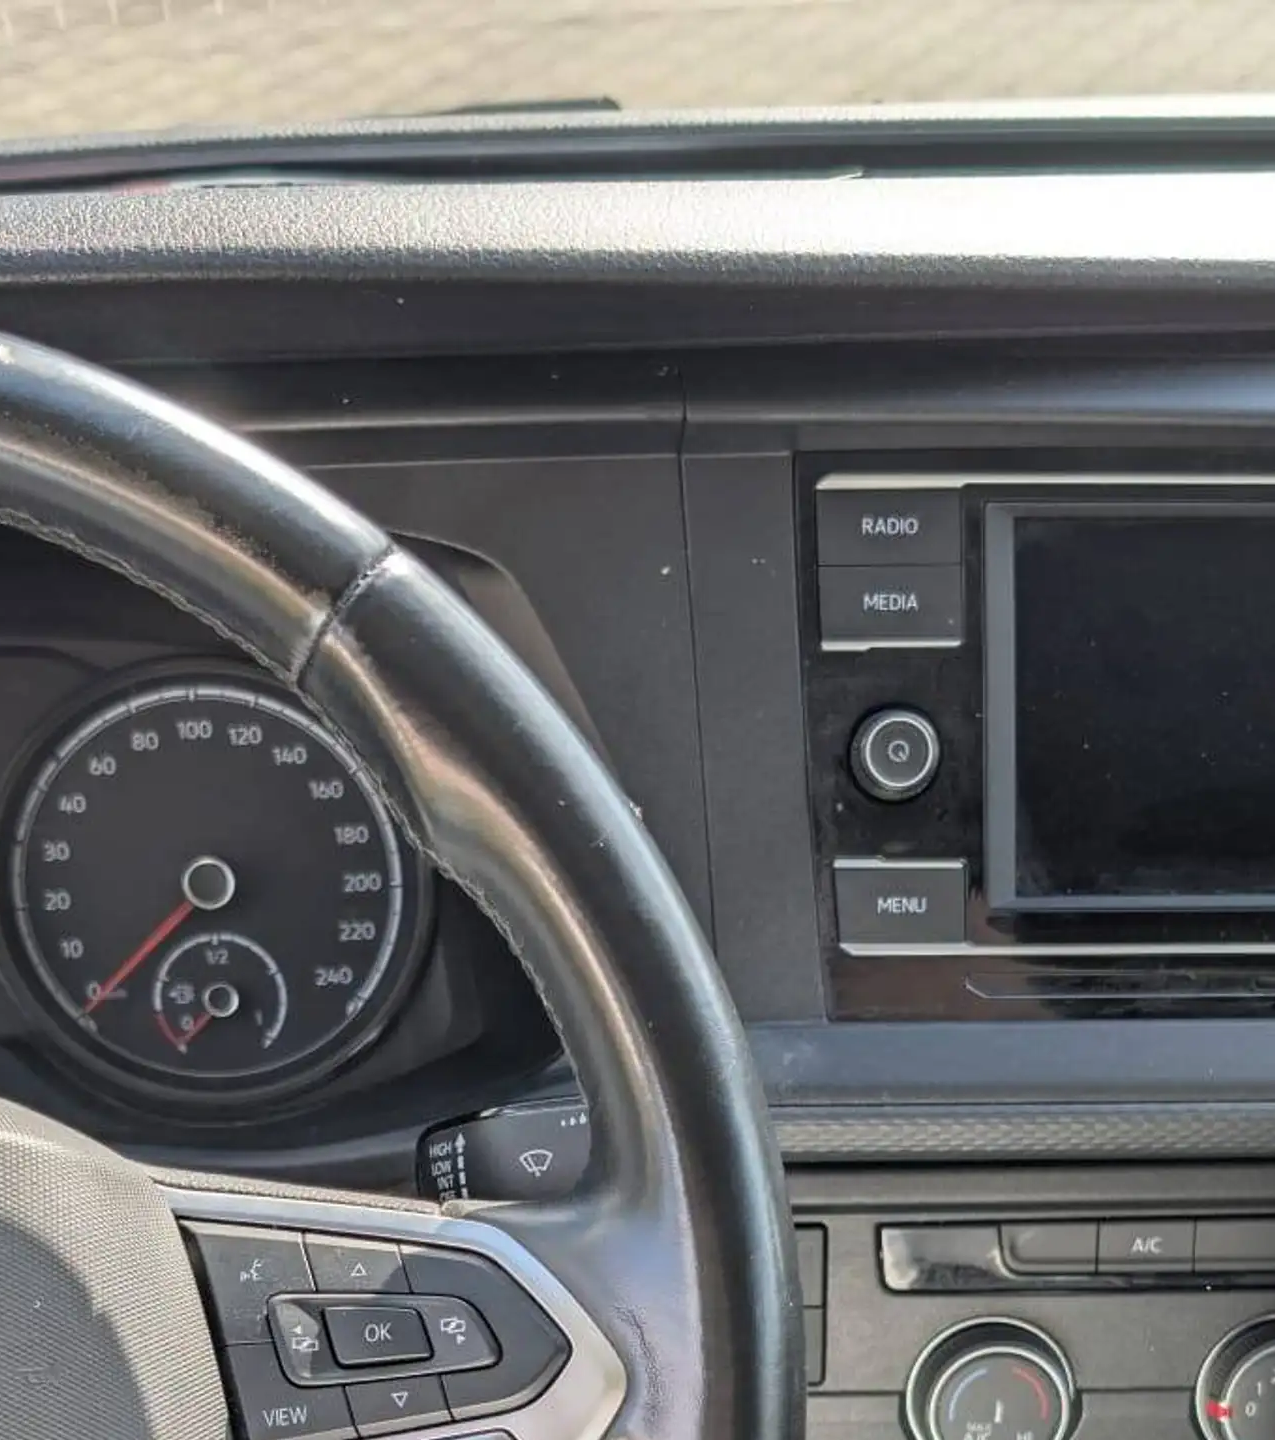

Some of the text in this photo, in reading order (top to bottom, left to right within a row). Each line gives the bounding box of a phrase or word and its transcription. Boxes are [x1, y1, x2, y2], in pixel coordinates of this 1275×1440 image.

[861, 517, 919, 535] RADIO
[862, 593, 920, 611] MEDIA
[177, 720, 213, 739] 100
[228, 727, 263, 746] 120
[131, 732, 159, 751] 80
[272, 747, 307, 765] 140
[88, 757, 116, 776] 60
[309, 781, 344, 799] 160
[59, 796, 87, 813] 40
[335, 826, 369, 844] 180
[43, 843, 70, 860] 30
[344, 873, 382, 891] 200
[44, 892, 71, 910] 20
[876, 897, 926, 914] MENU
[339, 921, 375, 940] 220
[61, 940, 84, 959] 10
[314, 968, 353, 986] 240
[428, 1141, 452, 1158] HIGH
[1132, 1237, 1163, 1254] A/C
[365, 1322, 393, 1343] OK
[262, 1406, 308, 1428] VIEW
